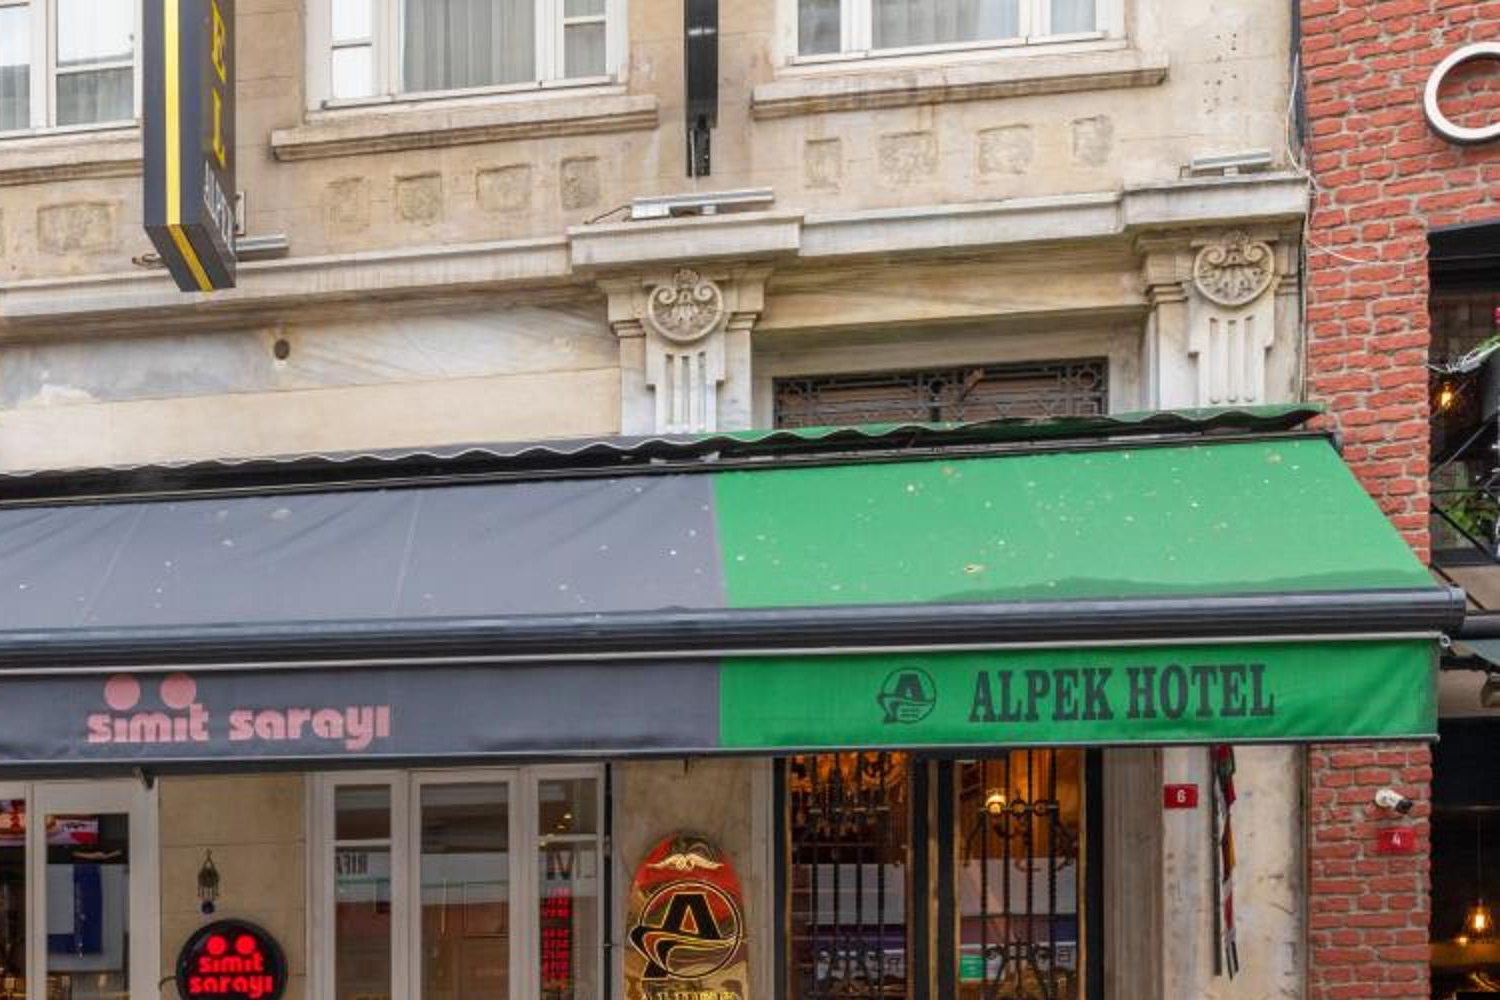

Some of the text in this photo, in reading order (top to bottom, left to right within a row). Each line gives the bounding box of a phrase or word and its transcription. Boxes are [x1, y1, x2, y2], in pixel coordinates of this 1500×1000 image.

[87, 672, 209, 743] simit
[968, 663, 1275, 723] ALPEK HOTEL
[1177, 789, 1187, 803] 6
[1391, 832, 1401, 846] 4
[199, 934, 264, 973] simit
